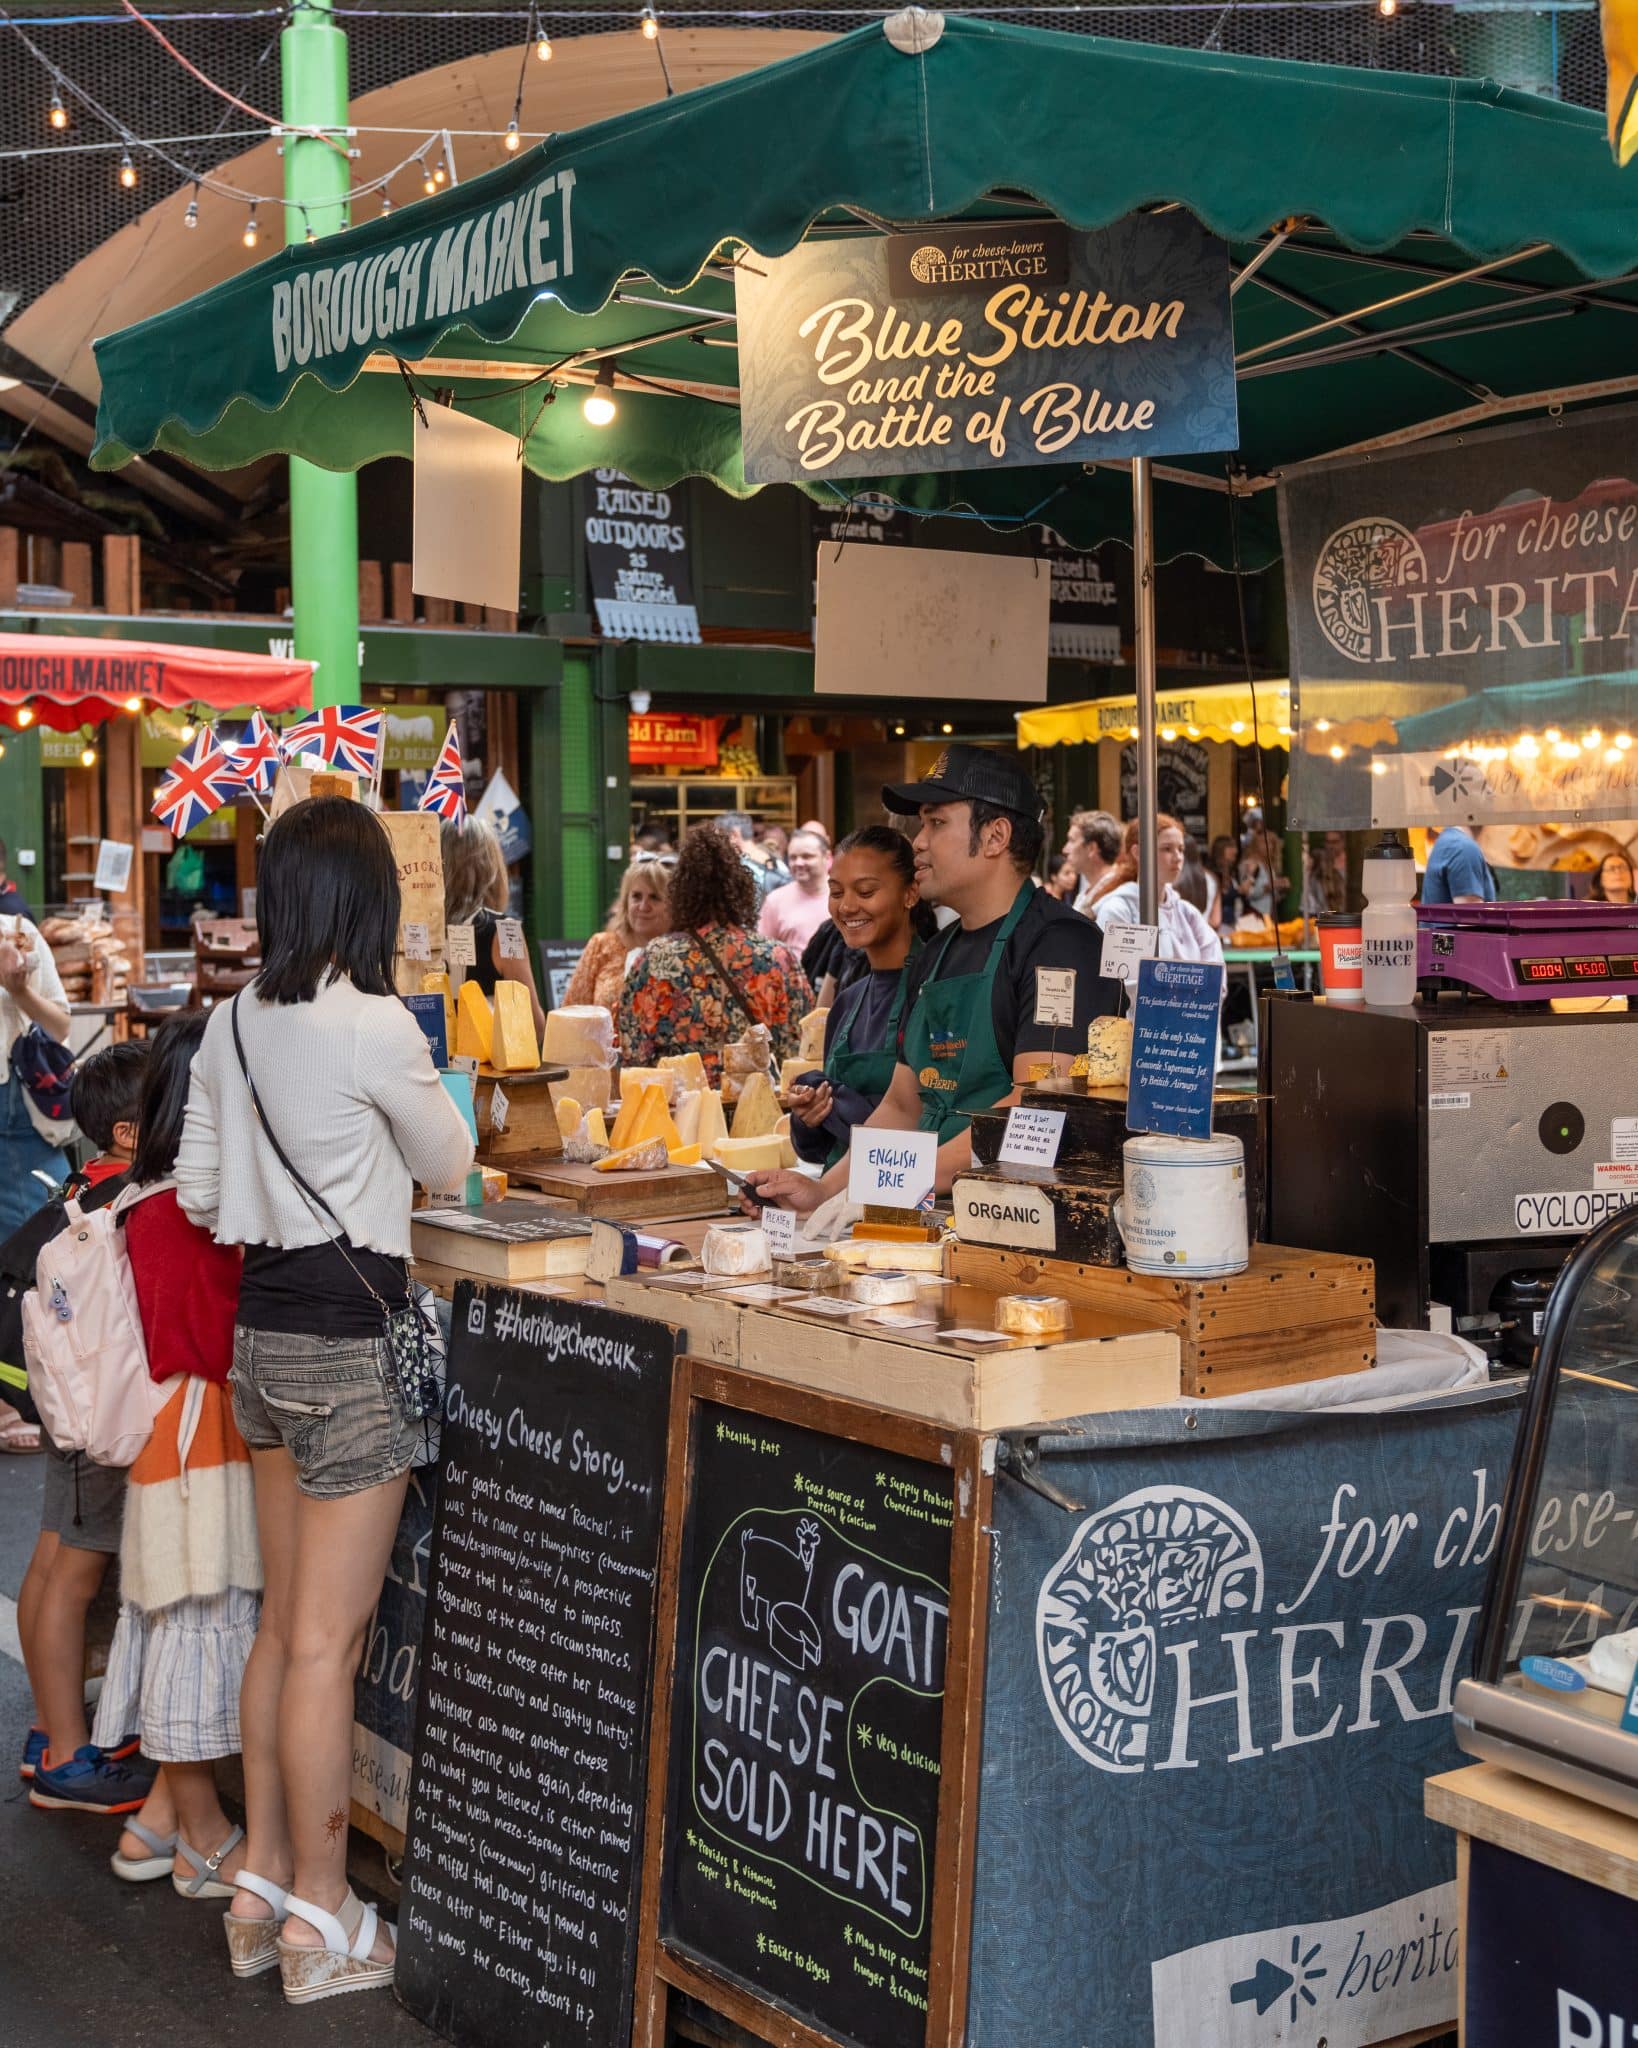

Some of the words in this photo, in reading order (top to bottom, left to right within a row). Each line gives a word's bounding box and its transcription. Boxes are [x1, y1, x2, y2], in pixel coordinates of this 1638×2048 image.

[952, 244, 968, 261] for
[972, 240, 1044, 258] cheese-lovers
[272, 246, 424, 372] BOROUGH
[425, 168, 577, 318] MARKET
[930, 257, 1047, 283] HERITAGE
[798, 298, 960, 385] Blue
[968, 283, 1184, 367] Stilton
[848, 366, 930, 404] and
[934, 363, 995, 399] the
[785, 399, 952, 470] Battle
[966, 397, 1011, 458] of
[1020, 382, 1155, 453] Blue
[596, 487, 671, 519] RAISED
[585, 517, 685, 552] OUTDOORS
[1437, 510, 1506, 583] for
[629, 553, 647, 568] as
[72, 658, 165, 693] MARKET
[1156, 700, 1195, 724] ARKET
[655, 722, 697, 742] Farm
[1365, 940, 1413, 951] THIRD
[1367, 955, 1411, 966] SPACE
[1161, 972, 1204, 985] HERITAGE
[1140, 1028, 1152, 1039] This
[1154, 1031, 1158, 1039] is
[1160, 1031, 1169, 1041] the
[1170, 1033, 1183, 1043] only
[1184, 1032, 1206, 1045] Stilton
[1152, 1046, 1158, 1054] be
[1160, 1047, 1177, 1057] served
[1188, 1050, 1198, 1059] the
[1136, 1059, 1162, 1070] Concorde
[1163, 1061, 1195, 1075] Supersonic
[1141, 1075, 1147, 1086] by
[1148, 1076, 1168, 1087] British
[1169, 1080, 1198, 1093] Airways
[868, 1148, 917, 1169] ENGLISH
[877, 1169, 905, 1189] BRIE
[968, 1201, 1040, 1225] ORGANIC
[1146, 1228, 1176, 1238] BISHOP
[447, 1384, 502, 1449] Cheesy
[507, 1408, 562, 1463] Cheese
[725, 1427, 756, 1451] healthy
[761, 1439, 781, 1456] fats
[447, 1461, 468, 1484] Our
[472, 1476, 501, 1500] goat's
[505, 1485, 533, 1510] cheese
[540, 1501, 566, 1521] named
[621, 1526, 633, 1543] it
[805, 1480, 823, 1495] Good
[827, 1488, 851, 1506] source
[854, 1499, 864, 1511] of
[890, 1477, 919, 1503] Supply
[445, 1499, 465, 1517] was
[472, 1508, 488, 1528] the
[494, 1518, 518, 1538] name
[524, 1531, 536, 1547] of
[1276, 1484, 1418, 1615] for
[476, 1568, 496, 1592] that
[503, 1579, 512, 1596] he
[518, 1588, 556, 1615] wanted
[564, 1604, 576, 1622] to
[438, 1581, 481, 1618] Regardless
[488, 1608, 497, 1624] of
[500, 1610, 514, 1629] the
[519, 1620, 545, 1642] exact
[833, 1563, 948, 1686] GOAT
[435, 1618, 446, 1641] he
[451, 1630, 480, 1653] named
[488, 1640, 501, 1659] the
[507, 1648, 536, 1674] cheese
[541, 1662, 568, 1685] after
[573, 1673, 591, 1694] her
[598, 1680, 636, 1715] because
[1533, 1659, 1574, 1682] maxima
[429, 1689, 473, 1728] Whitelake
[478, 1716, 497, 1733] also
[502, 1724, 525, 1744] make
[530, 1734, 569, 1759] another
[701, 1646, 844, 1780] CHEESE
[700, 1738, 791, 1841] SOLD
[806, 1790, 916, 1917] HERE
[699, 1839, 727, 1867] Provides
[413, 1837, 433, 1859] got
[438, 1853, 468, 1881] miffed
[473, 1872, 493, 1893] that
[497, 1884, 528, 1913] no-one
[532, 1898, 550, 1925] had
[555, 1914, 584, 1941] named
[590, 1931, 599, 1949] a
[409, 1906, 433, 1942] fairly
[438, 1931, 466, 1956] warms
[473, 1949, 489, 1971] the
[855, 1932, 875, 1956] May
[879, 1943, 896, 1965] help
[769, 1939, 792, 1963] Easier
[795, 1952, 804, 1967] to
[806, 1957, 830, 1983] digest
[853, 1957, 884, 1987] hunger
